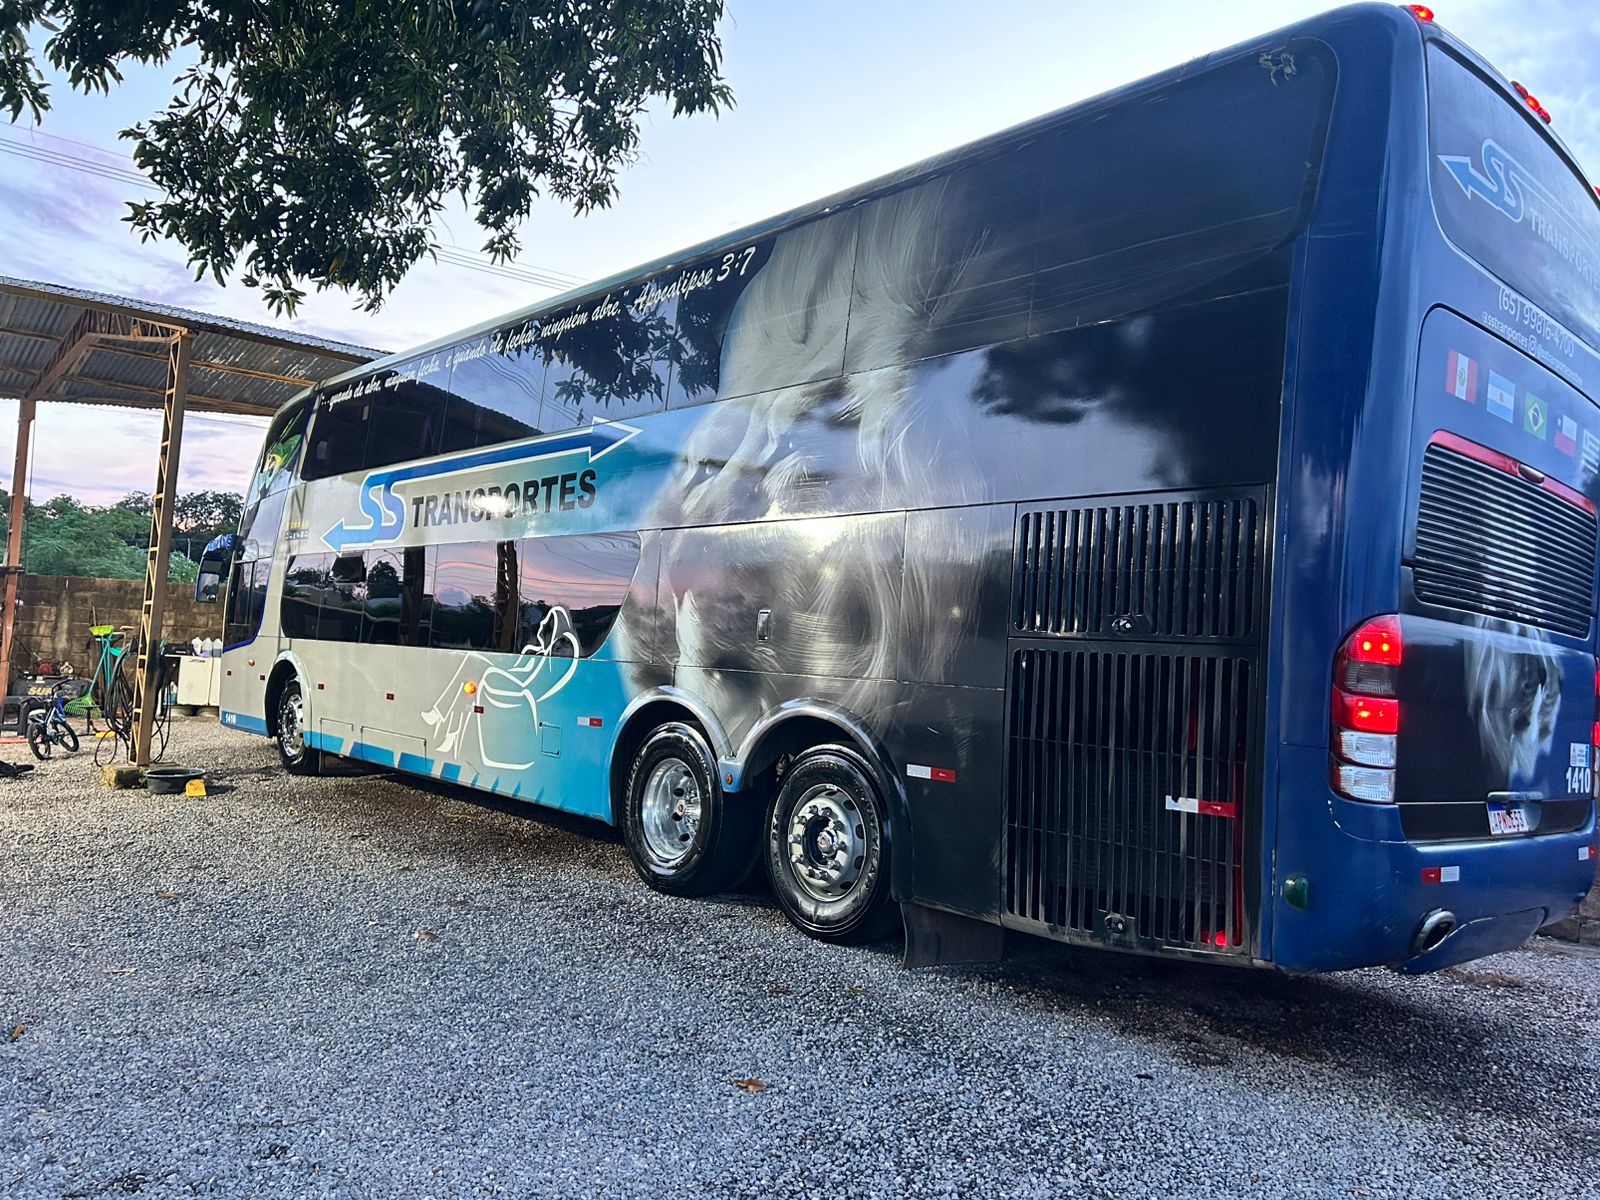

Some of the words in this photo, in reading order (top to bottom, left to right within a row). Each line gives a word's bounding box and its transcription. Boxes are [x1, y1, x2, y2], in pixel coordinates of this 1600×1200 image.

[541, 304, 588, 341] ninguém
[630, 270, 714, 314] Apocalipse
[716, 246, 756, 282] 3:7
[1498, 287, 1521, 322] (65)
[412, 469, 597, 528] TRANSPORTES
[1565, 766, 1591, 793] 1410
